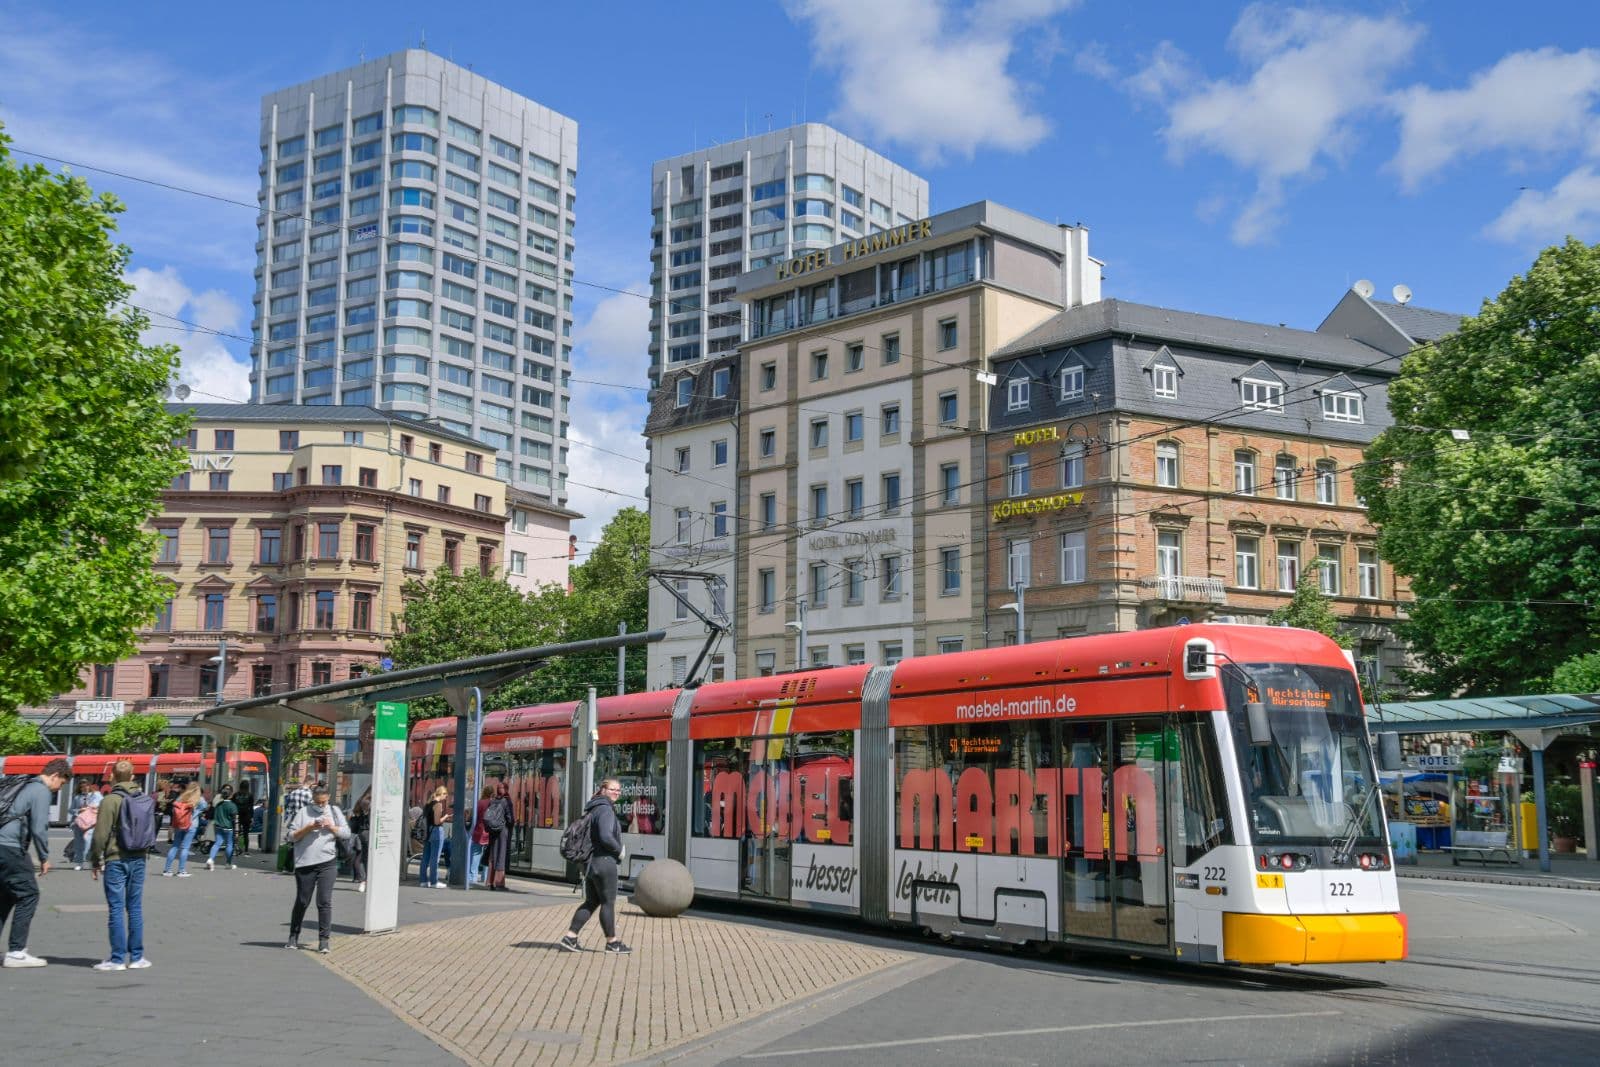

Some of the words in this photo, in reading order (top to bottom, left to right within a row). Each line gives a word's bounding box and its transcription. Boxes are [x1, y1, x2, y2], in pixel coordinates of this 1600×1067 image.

[775, 249, 833, 280] HOTEL
[843, 219, 933, 262] HAMMER
[1014, 427, 1060, 446] HOTEL
[992, 494, 1071, 518] KÖNIGSHOF
[1267, 687, 1332, 700] Hechtsheim
[956, 694, 1077, 719] moebel-martin.de
[949, 738, 958, 753] 50
[1204, 866, 1226, 881] 222
[1329, 882, 1354, 897] 222
